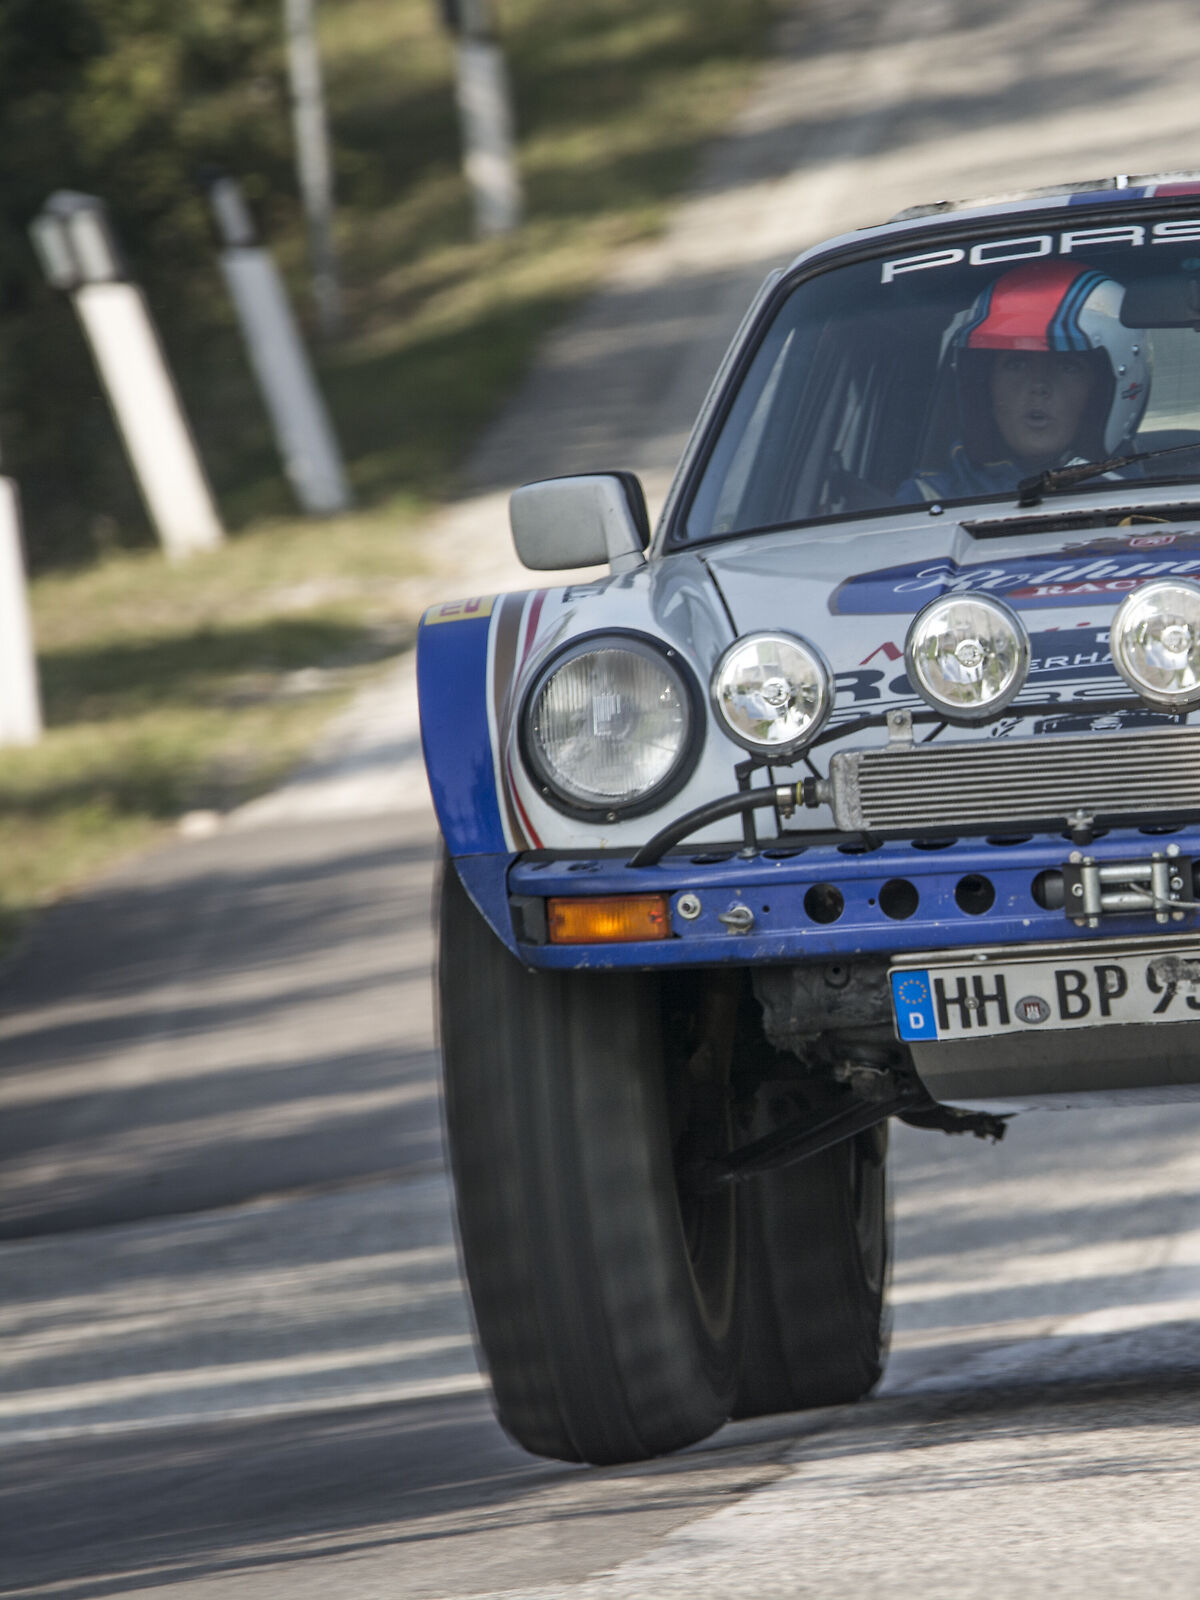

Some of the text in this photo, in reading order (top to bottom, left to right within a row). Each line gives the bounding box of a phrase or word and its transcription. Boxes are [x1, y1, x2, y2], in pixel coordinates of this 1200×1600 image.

[934, 973, 1011, 1030] HH
[1054, 964, 1128, 1021] BP
[909, 1013, 925, 1030] D
